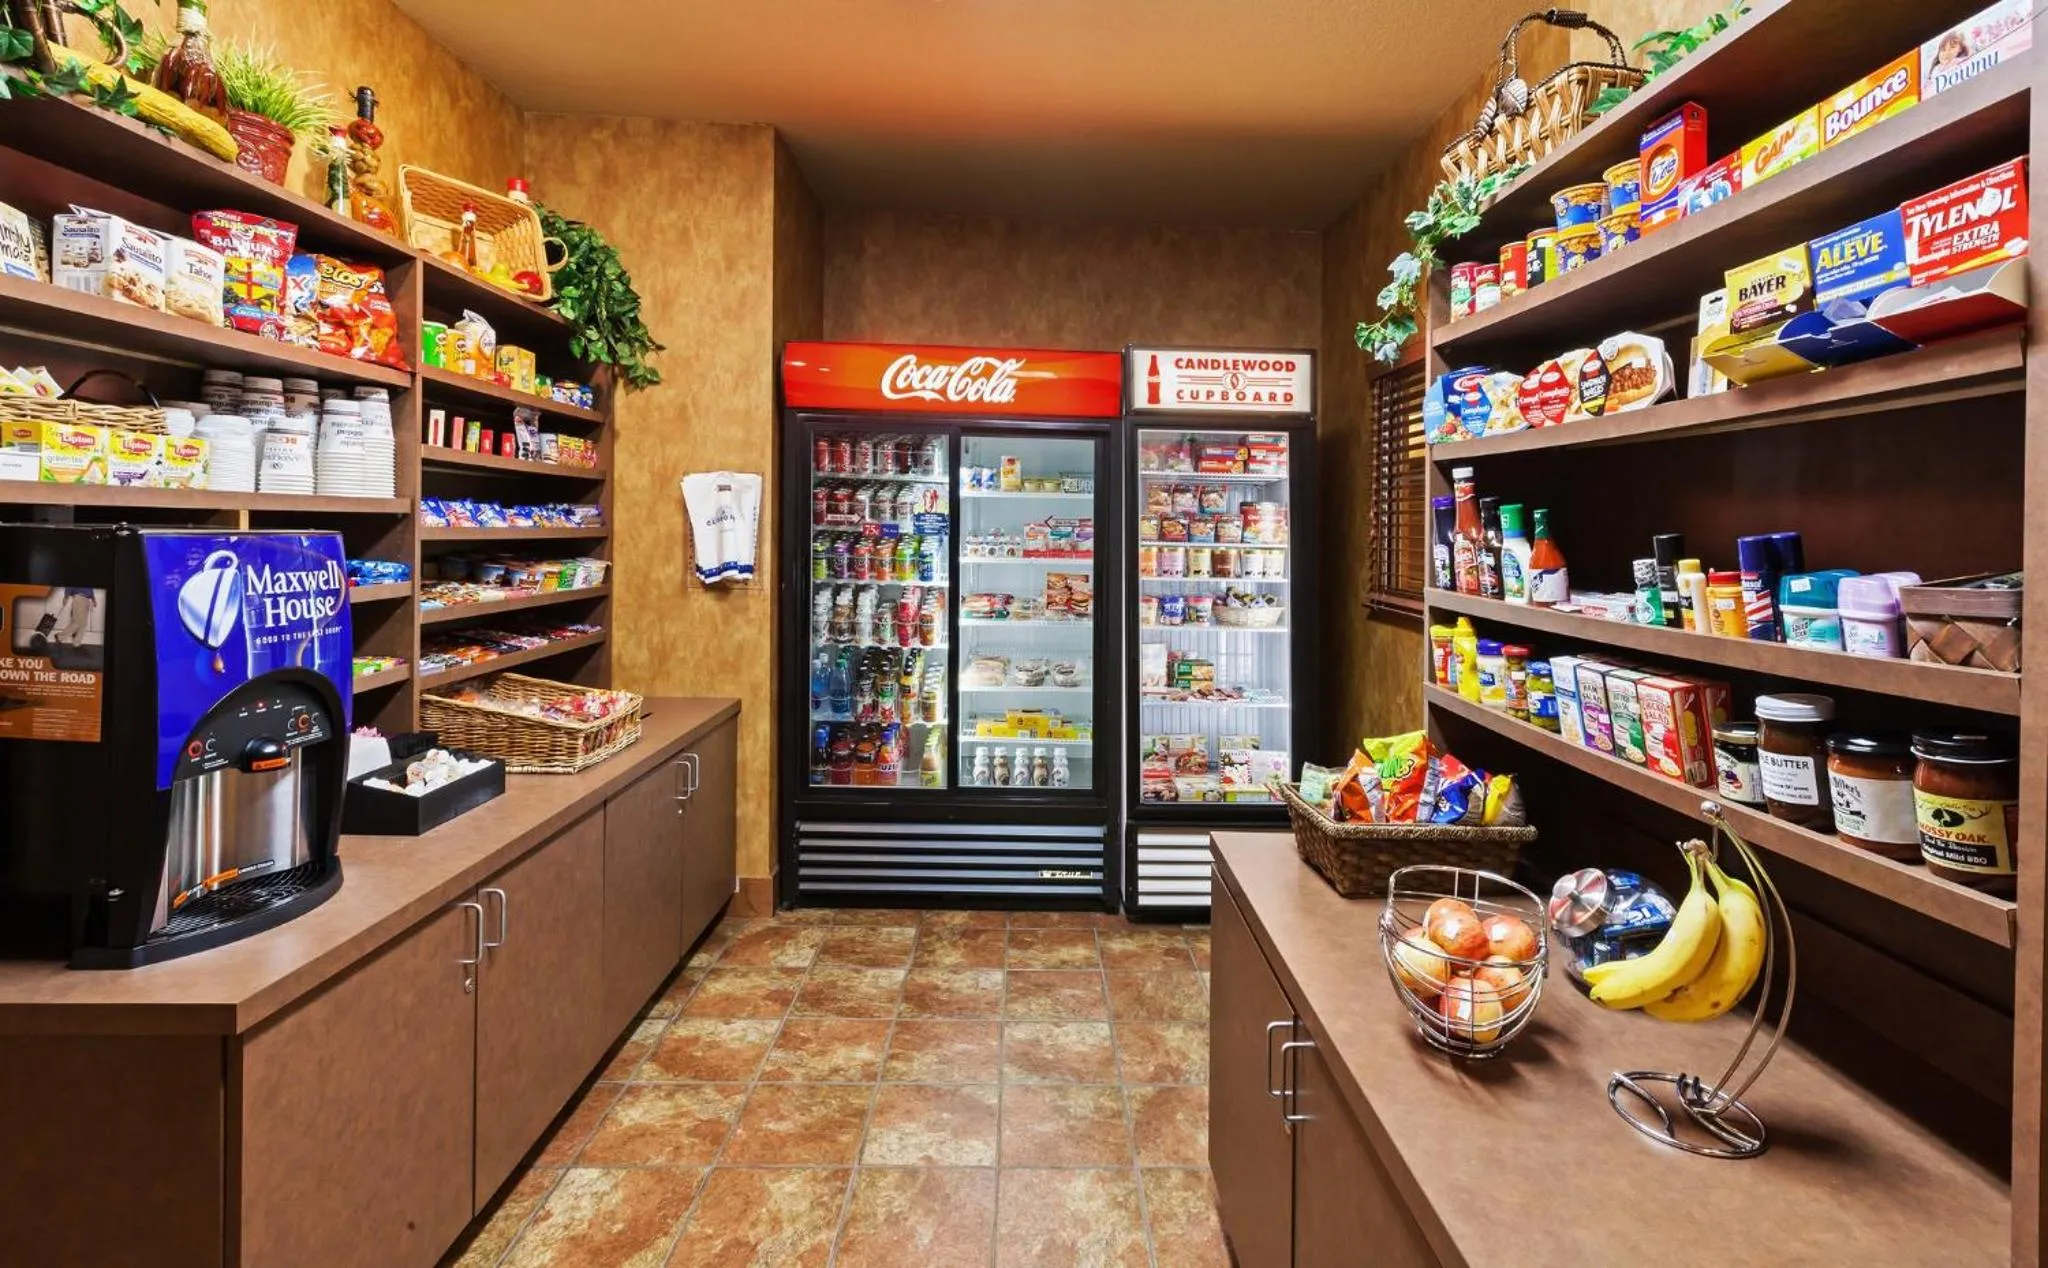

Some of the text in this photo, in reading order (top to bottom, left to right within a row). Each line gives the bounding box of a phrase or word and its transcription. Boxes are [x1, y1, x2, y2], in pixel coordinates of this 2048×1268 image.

[1935, 51, 1999, 94] Downy
[1825, 68, 1908, 143] Bounce
[63, 225, 100, 234] Sausalito
[1905, 186, 2016, 265] TYLENOL
[1953, 220, 2000, 245] EXTRA
[122, 237, 162, 264] Sausalito
[1816, 232, 1883, 273] ALEVE
[1951, 232, 2000, 254] STRENGTH
[187, 262, 212, 281] Tahoe
[1739, 274, 1787, 302] BAYER
[1175, 358, 1296, 372] CANDLEWOOD
[881, 354, 1017, 403] Coca-Cola
[1176, 389, 1294, 403] CUPBOARD
[62, 434, 95, 446] Lipton
[125, 440, 151, 451] Lipton
[175, 446, 200, 457] Lipton
[246, 561, 340, 595] Maxwell
[263, 596, 336, 628] House
[18, 659, 43, 670] YOU
[34, 671, 57, 682] THE
[60, 673, 96, 685] ROAD
[1771, 757, 1809, 769] BUTTER
[1955, 832, 1987, 843] OAK
[1945, 852, 1965, 861] Mild
[1967, 856, 1988, 865] BBQ
